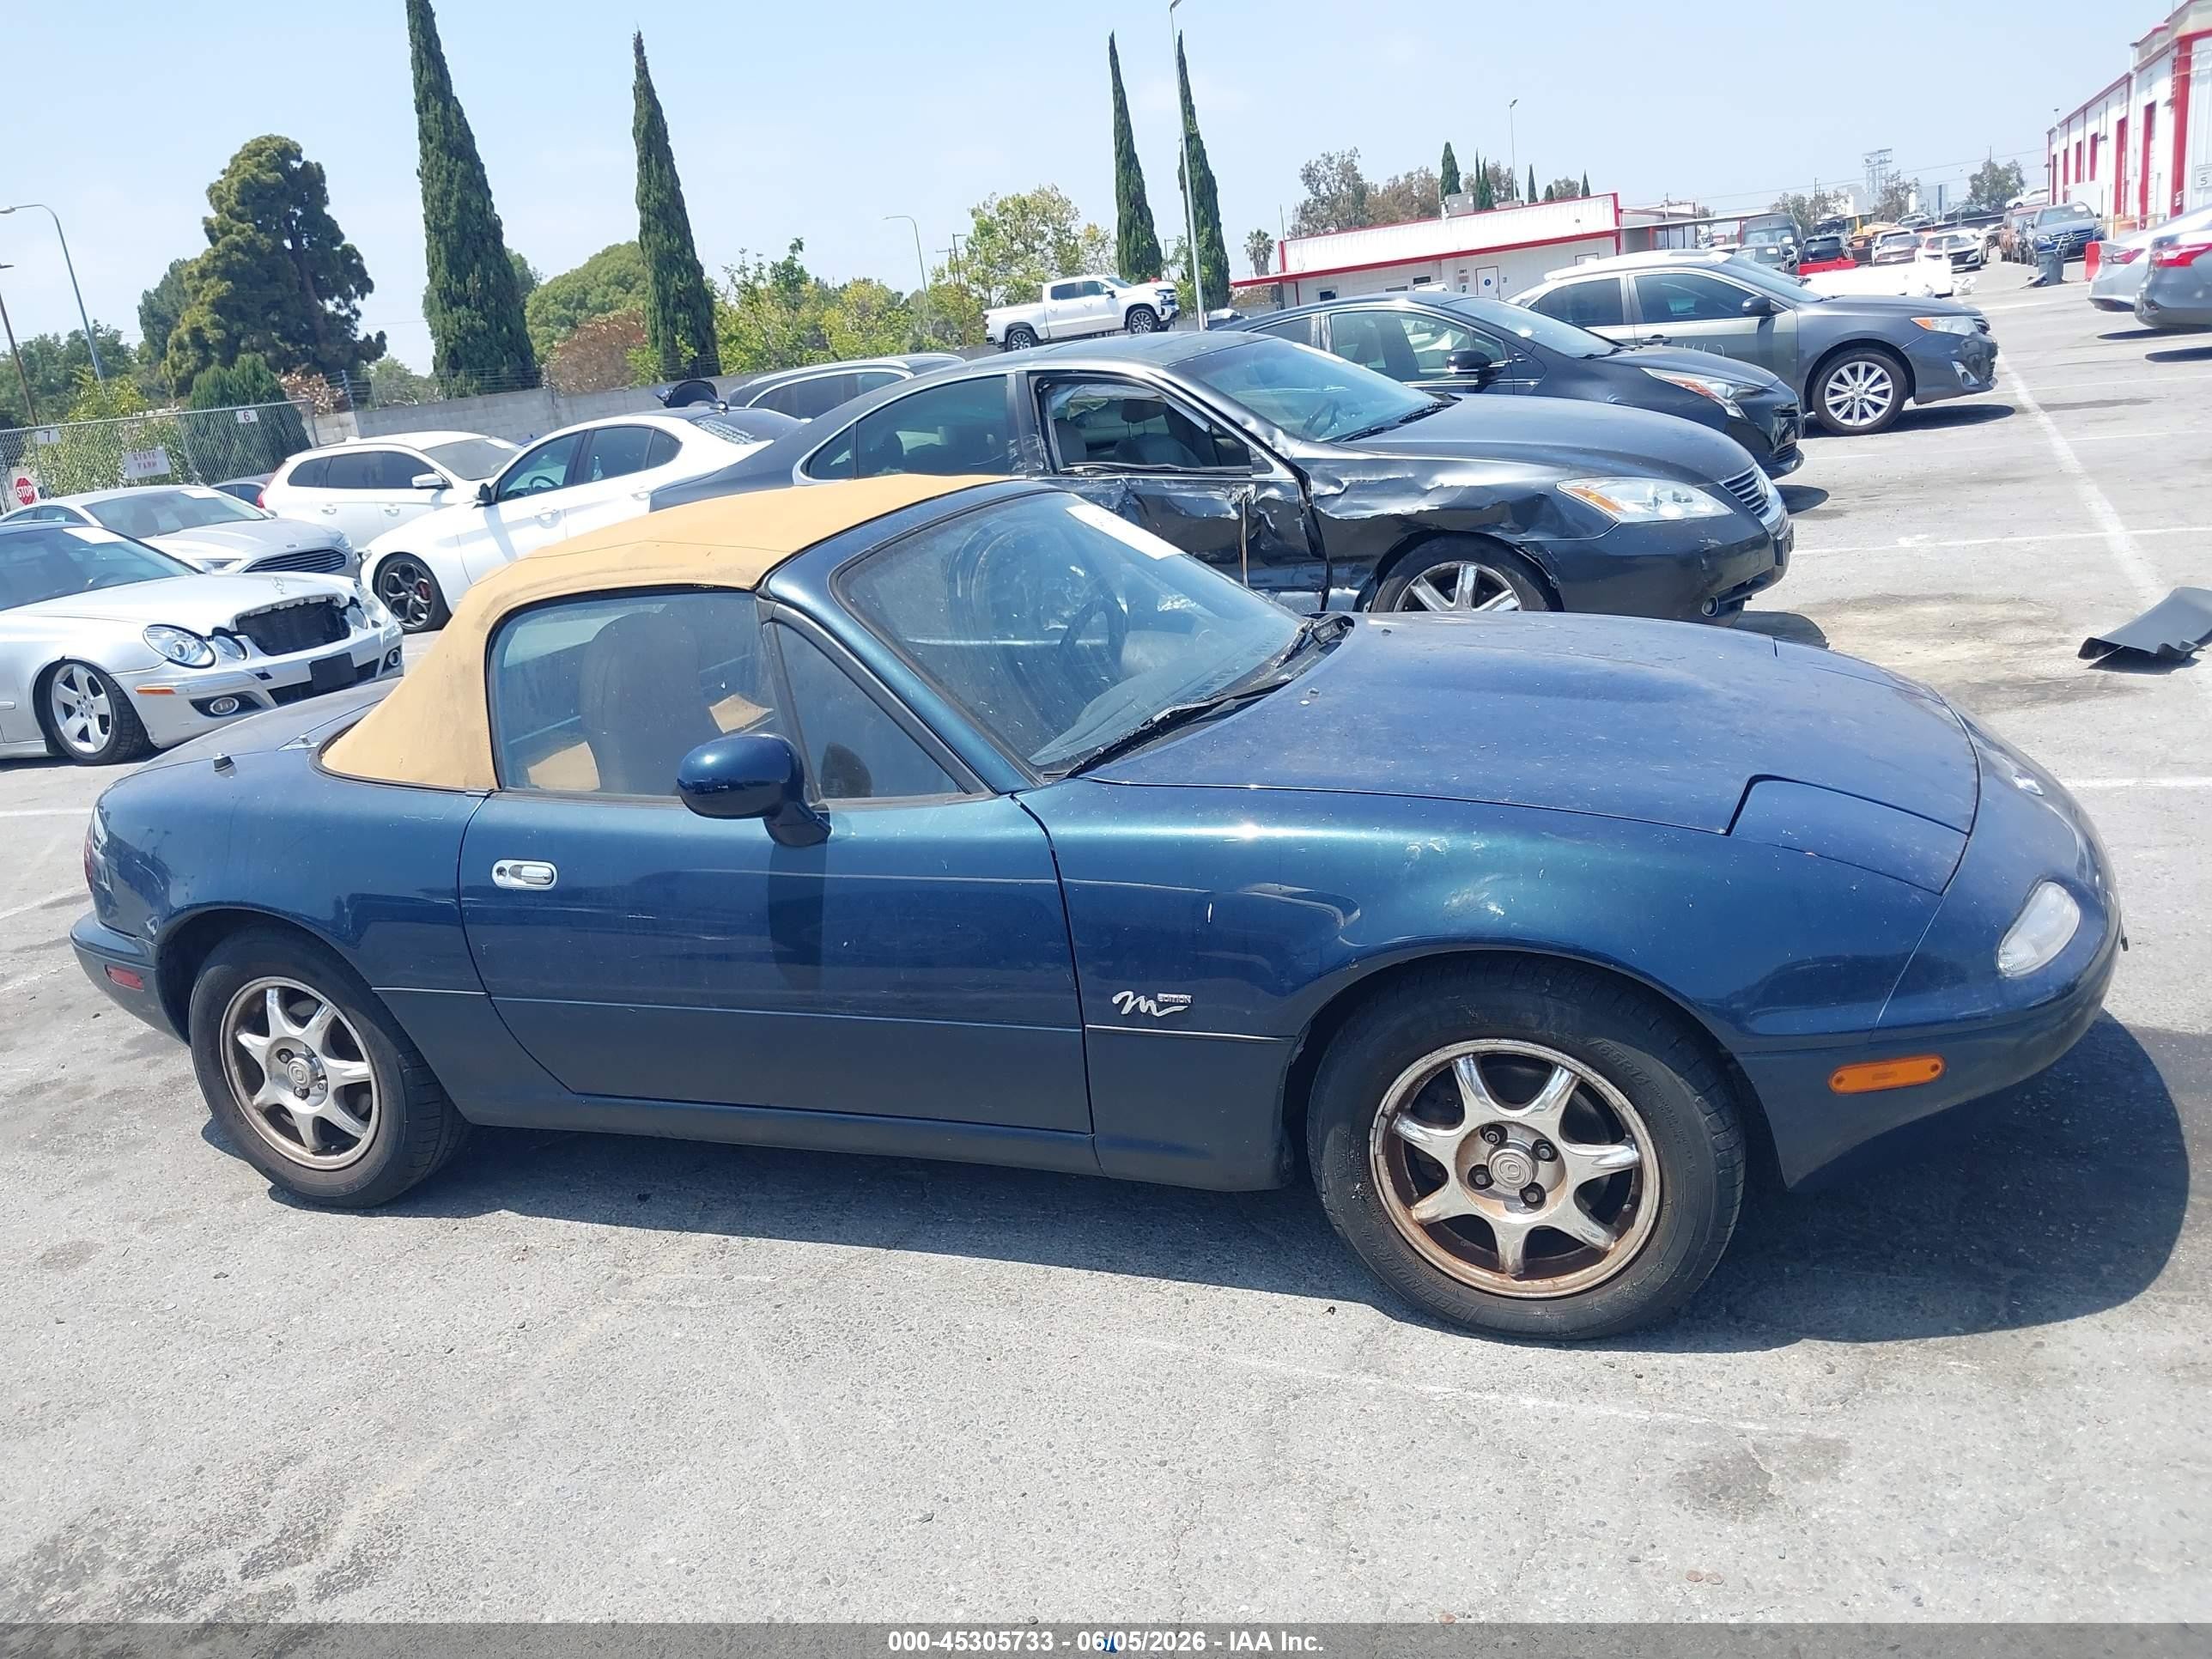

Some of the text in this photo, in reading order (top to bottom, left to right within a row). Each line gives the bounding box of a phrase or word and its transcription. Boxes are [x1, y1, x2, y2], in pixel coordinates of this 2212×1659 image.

[243, 411, 251, 422] 6
[43, 430, 51, 442] 7
[16, 485, 33, 498] STOP
[1157, 993, 1193, 1004] EDITION
